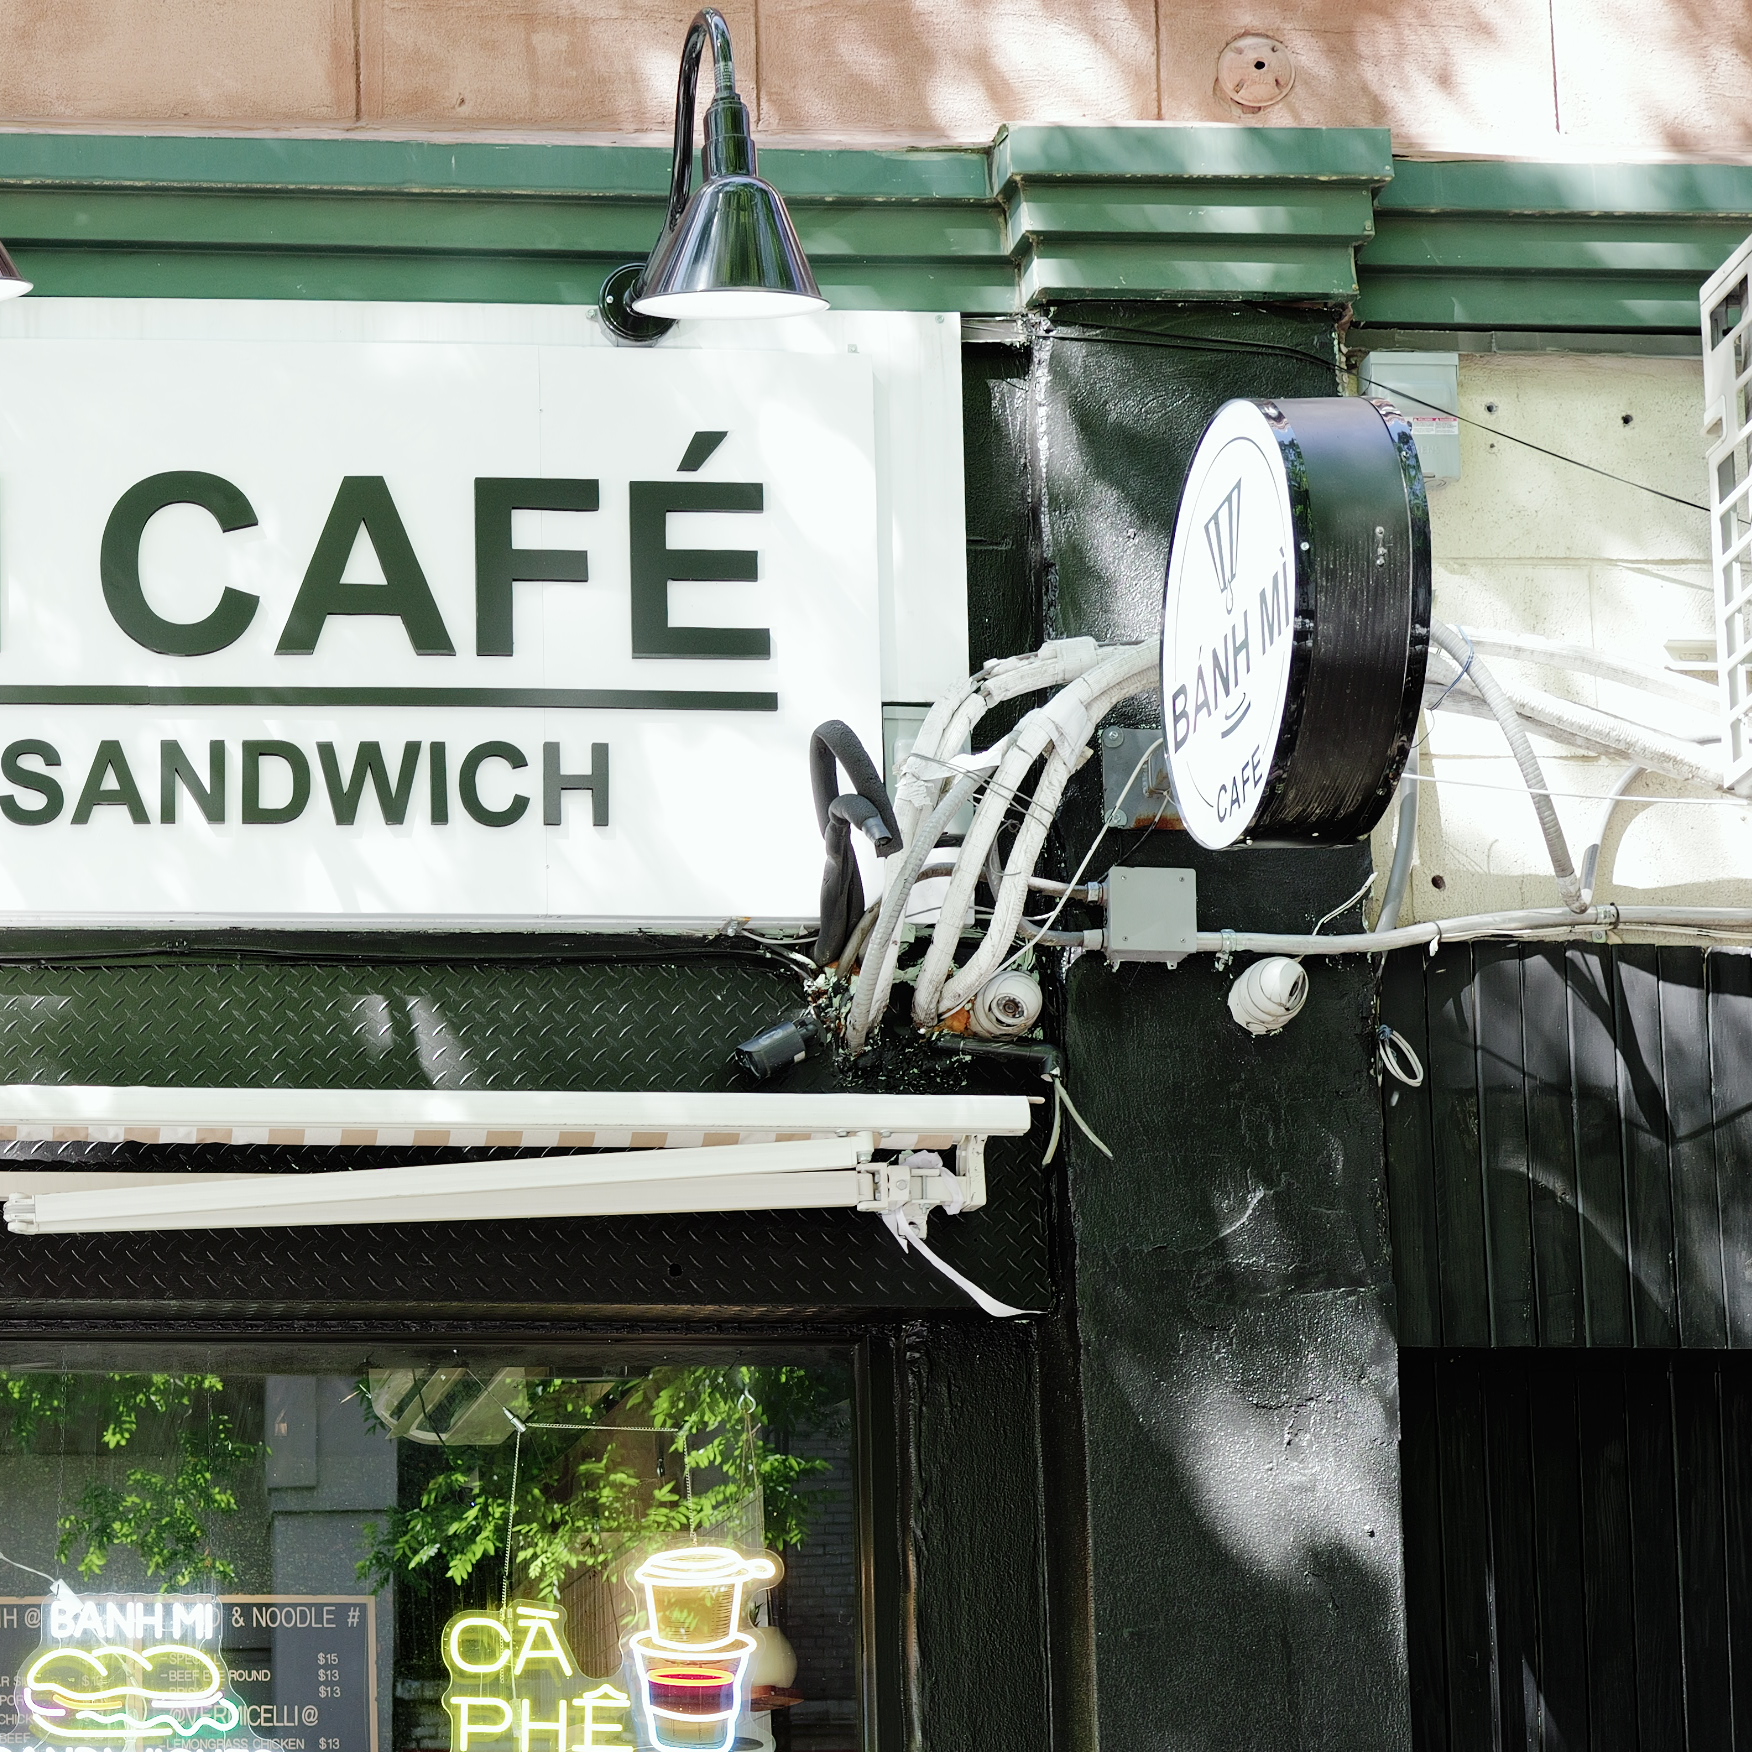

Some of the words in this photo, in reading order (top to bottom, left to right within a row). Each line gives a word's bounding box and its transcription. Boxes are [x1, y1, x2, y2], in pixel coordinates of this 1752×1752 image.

[100, 431, 771, 660] CAFÉ
[1172, 608, 1250, 755] BÁNH
[1259, 546, 1290, 656] MÌ
[0, 739, 610, 827] SANDWICH
[1217, 744, 1263, 823] CAFE
[50, 1600, 162, 1639] BANH
[172, 1602, 213, 1639] MI
[231, 1607, 246, 1628] &
[253, 1606, 336, 1628] NOODLE
[317, 1652, 339, 1666] $15
[229, 1670, 271, 1682] ROUND
[318, 1669, 340, 1682] $13
[0, 1696, 28, 1707] POR
[319, 1685, 341, 1699] $13
[450, 1684, 634, 1752] PHÊ
[252, 1738, 305, 1750] CHICKEN
[319, 1737, 340, 1750] $13
